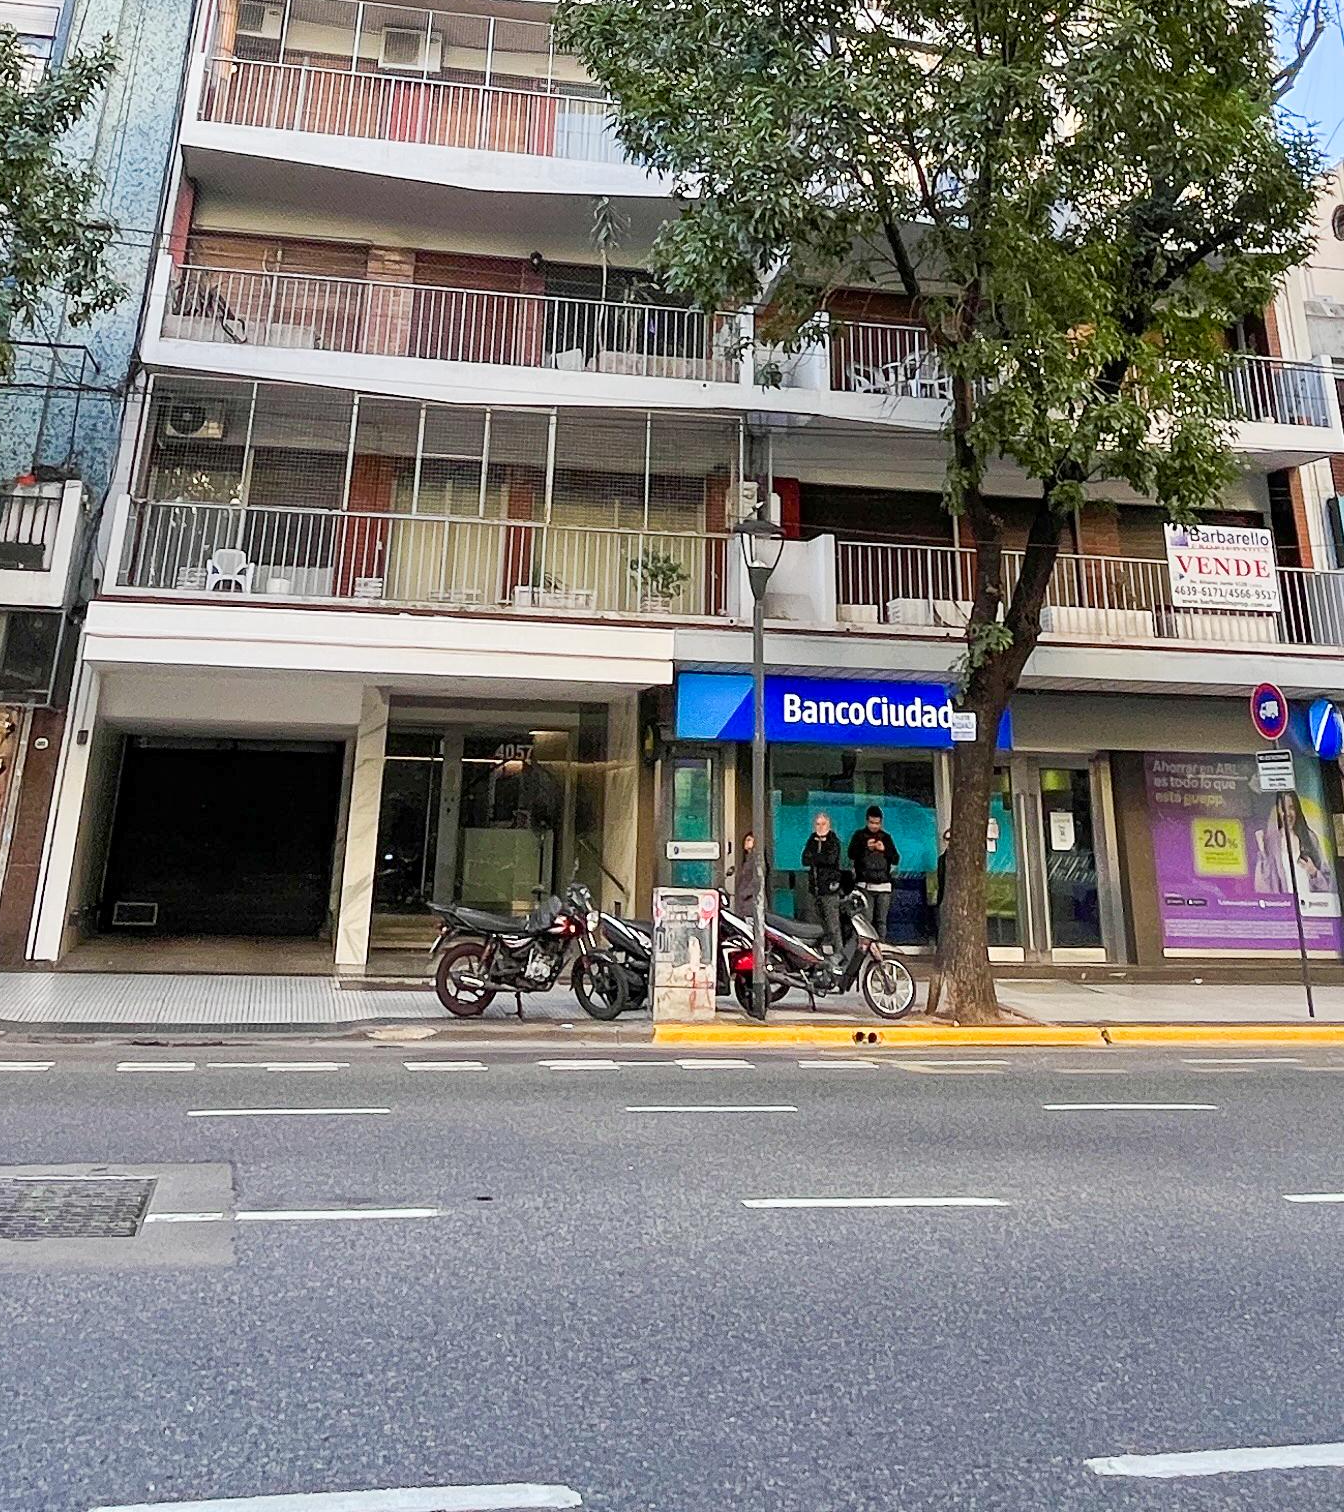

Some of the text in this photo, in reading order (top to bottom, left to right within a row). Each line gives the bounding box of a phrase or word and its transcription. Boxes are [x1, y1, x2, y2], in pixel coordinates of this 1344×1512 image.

[1190, 528, 1269, 546] Barbarello
[1175, 555, 1271, 578] VENDE
[783, 693, 954, 729] BancoCiudad
[495, 743, 534, 765] 4057
[1170, 776, 1198, 789] todo
[1213, 779, 1236, 792] que
